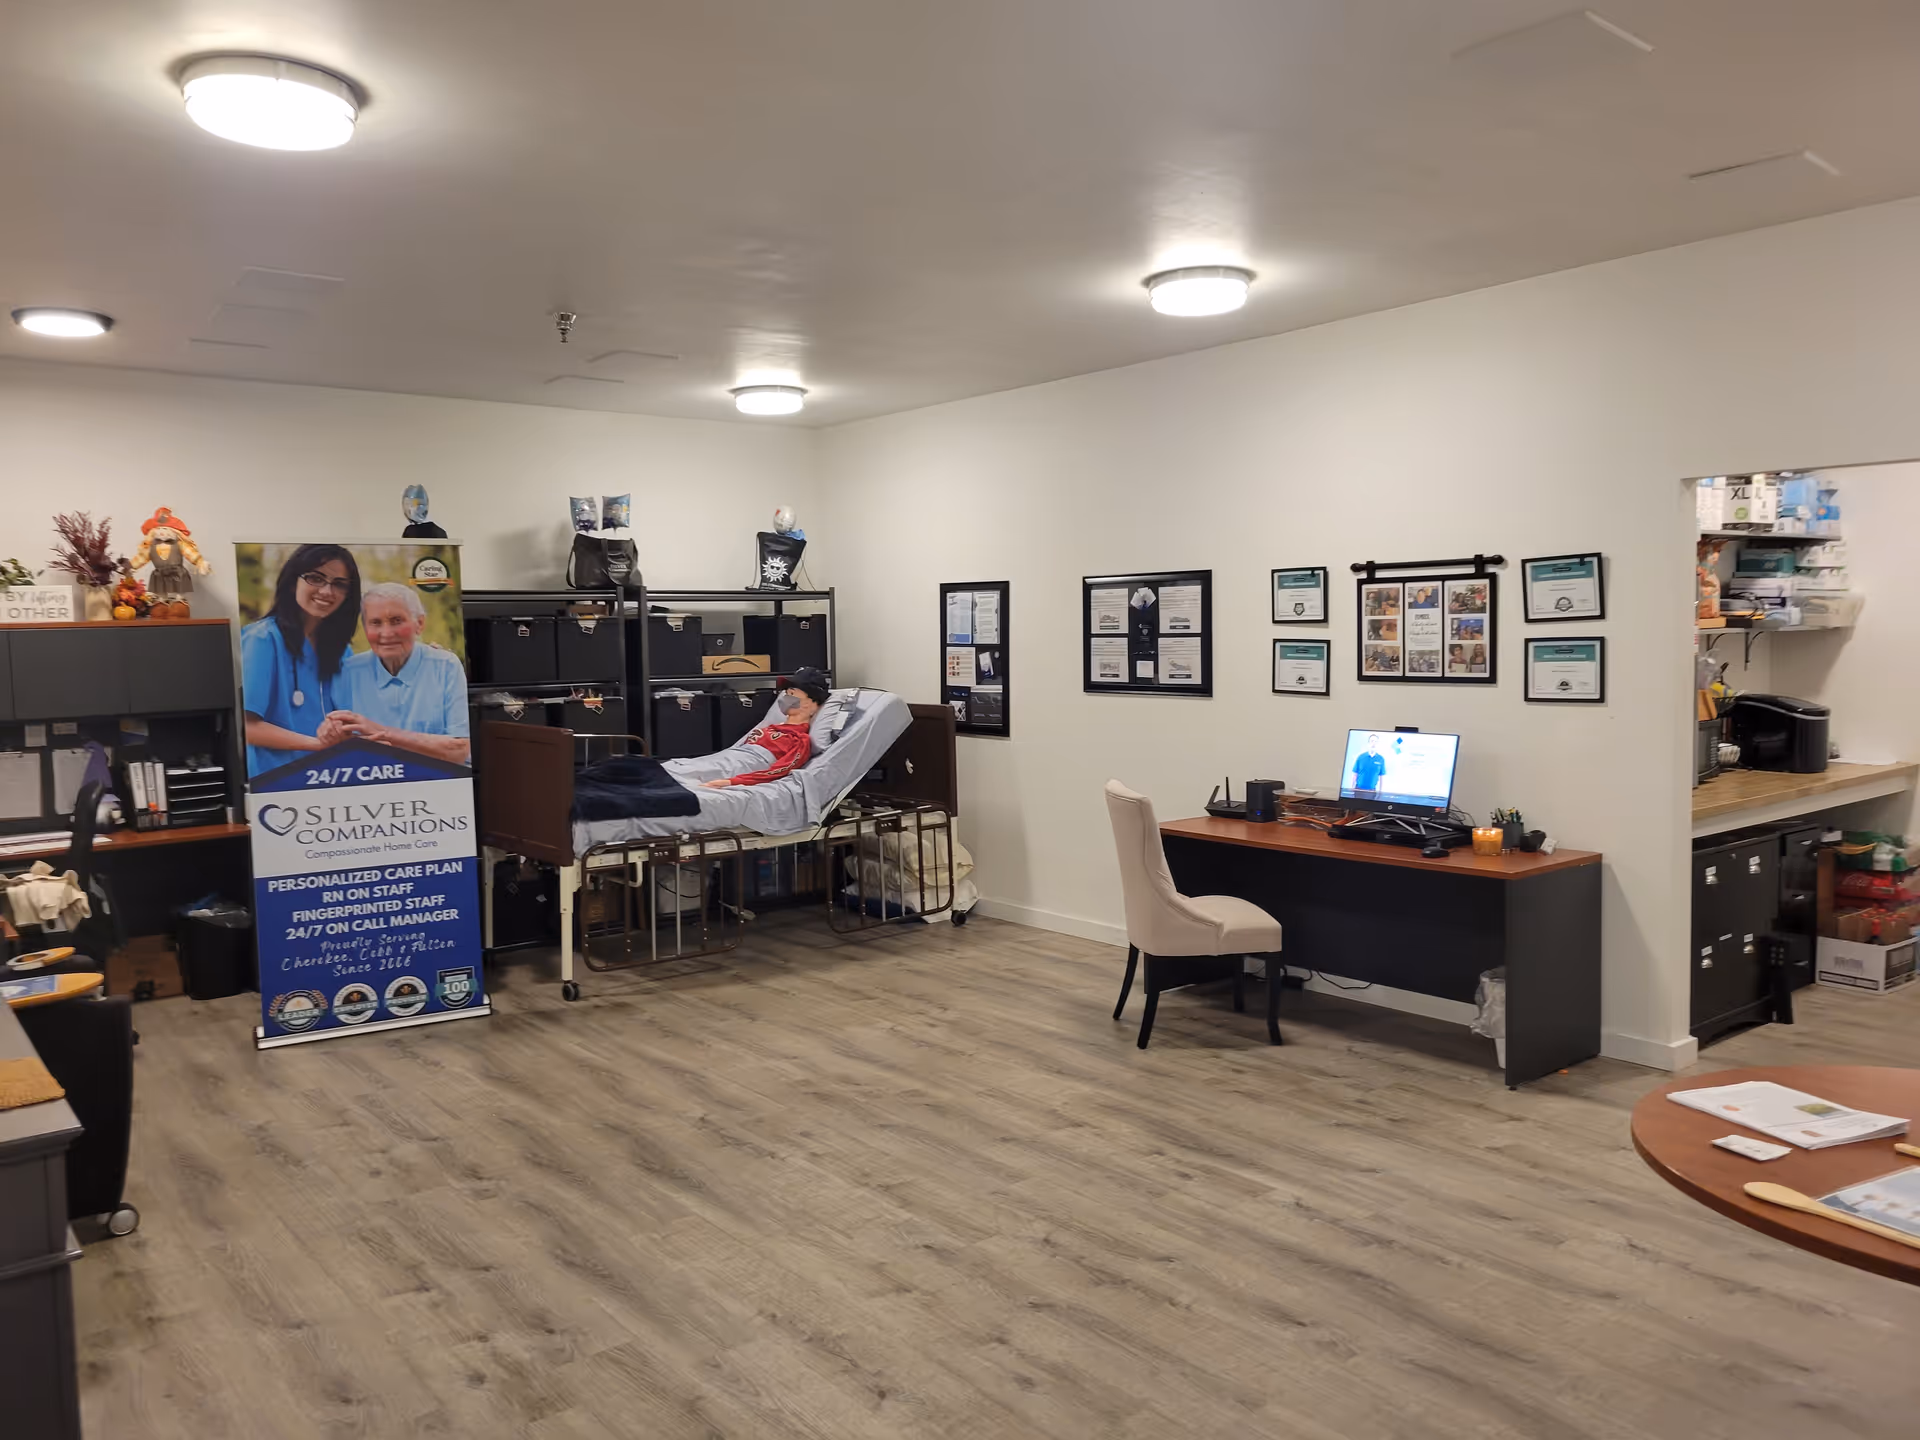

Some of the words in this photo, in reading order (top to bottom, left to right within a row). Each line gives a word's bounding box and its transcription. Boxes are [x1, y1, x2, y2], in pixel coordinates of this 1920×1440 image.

[1730, 487, 1750, 500] XL
[419, 565, 443, 573] Caring
[8, 608, 69, 618] OTHER
[306, 768, 353, 785] 24/7
[356, 764, 404, 781] CARE
[305, 800, 436, 826] SILVER
[296, 816, 468, 845] COMPANIONS
[305, 845, 382, 860] Compassionate
[384, 842, 412, 856] Home
[414, 840, 438, 849] Care
[268, 870, 382, 892] PERSONALIZED
[384, 865, 423, 880] CARE
[426, 861, 463, 876] PLAN
[322, 890, 344, 904] RN
[346, 887, 370, 900] ON
[372, 882, 414, 898] STAFF
[292, 900, 402, 923] FINGERPRINTED
[405, 894, 446, 910] STAFF
[285, 924, 323, 940] 24/7
[326, 922, 350, 935] ON
[352, 917, 388, 932] CALL
[390, 908, 460, 928] MANAGER
[320, 937, 372, 954] Proudly
[378, 932, 426, 945] Serving
[411, 939, 456, 953] Fulton
[332, 963, 372, 978] Since
[443, 980, 470, 994] 100
[278, 1008, 320, 1020] LEADER
